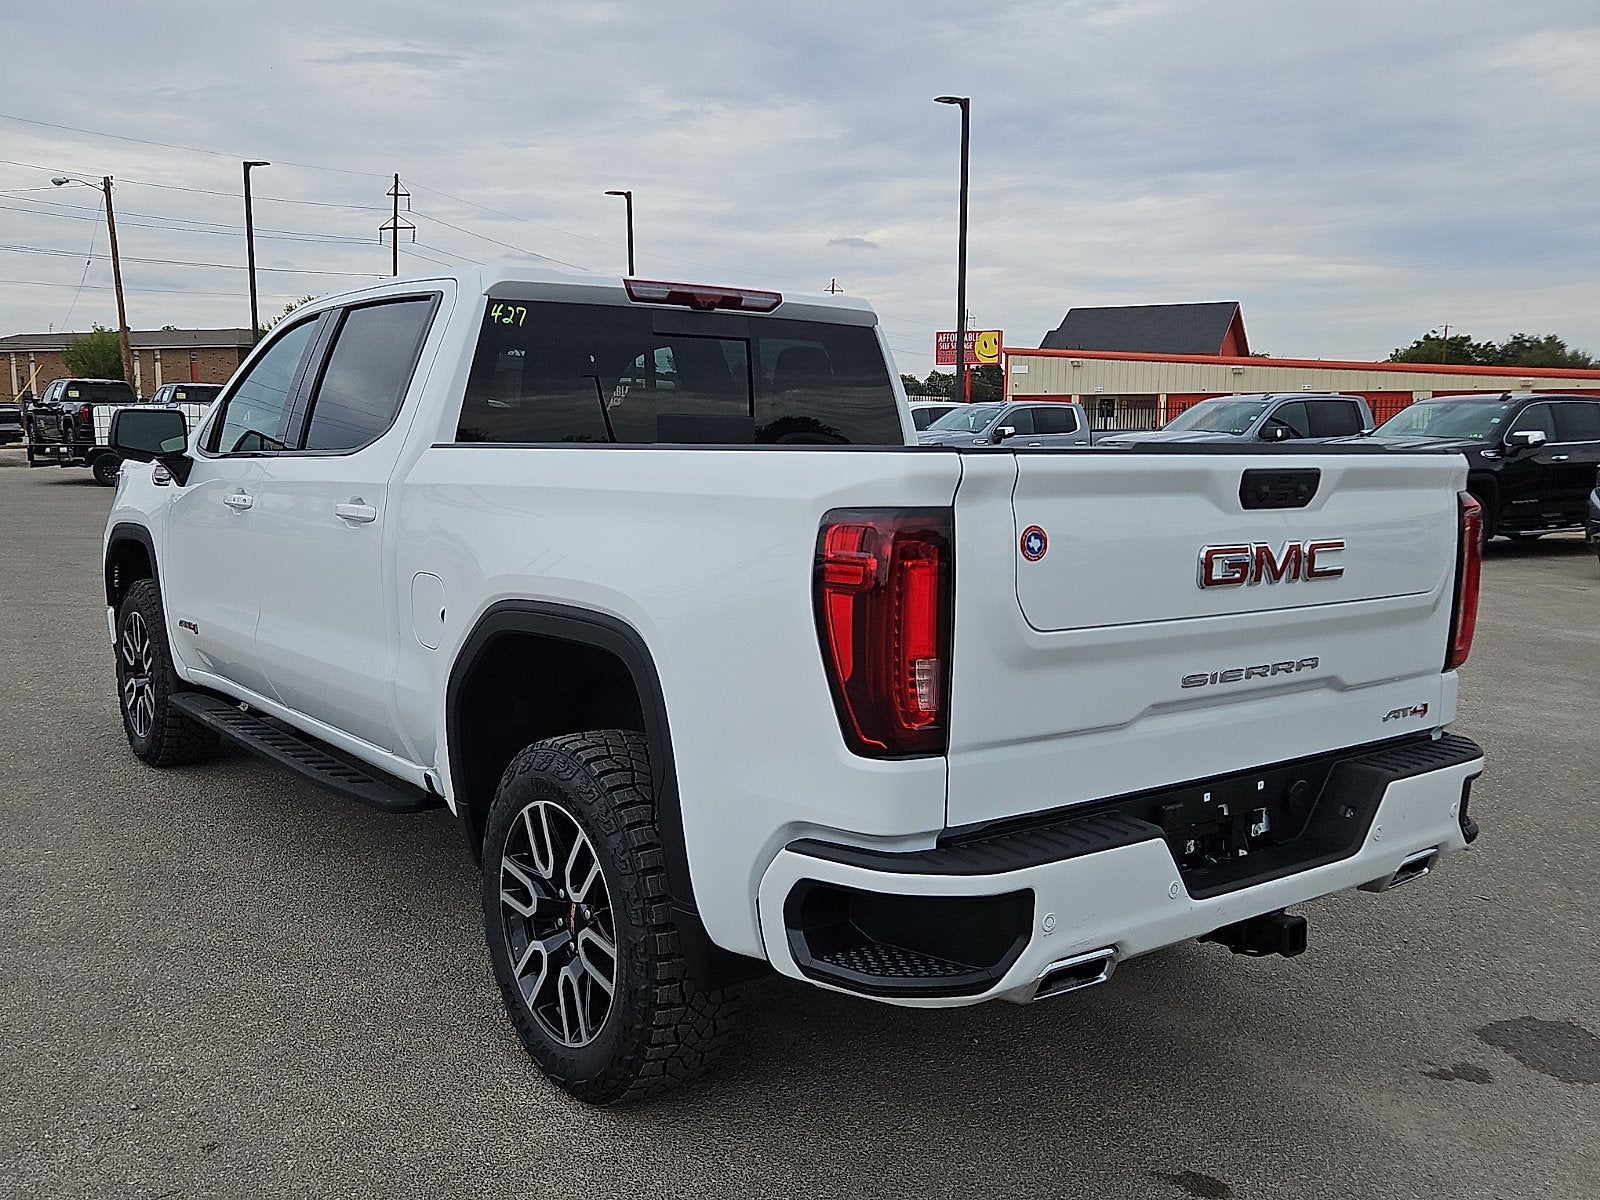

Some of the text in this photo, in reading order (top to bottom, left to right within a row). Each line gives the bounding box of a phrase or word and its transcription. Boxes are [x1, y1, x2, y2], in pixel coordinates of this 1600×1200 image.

[491, 304, 527, 327] 427
[938, 332, 980, 342] AFFOABLE
[951, 342, 973, 350] STAGE
[1197, 538, 1345, 589] GMC
[1181, 656, 1320, 688] SIERRA
[1382, 702, 1429, 722] AT4
